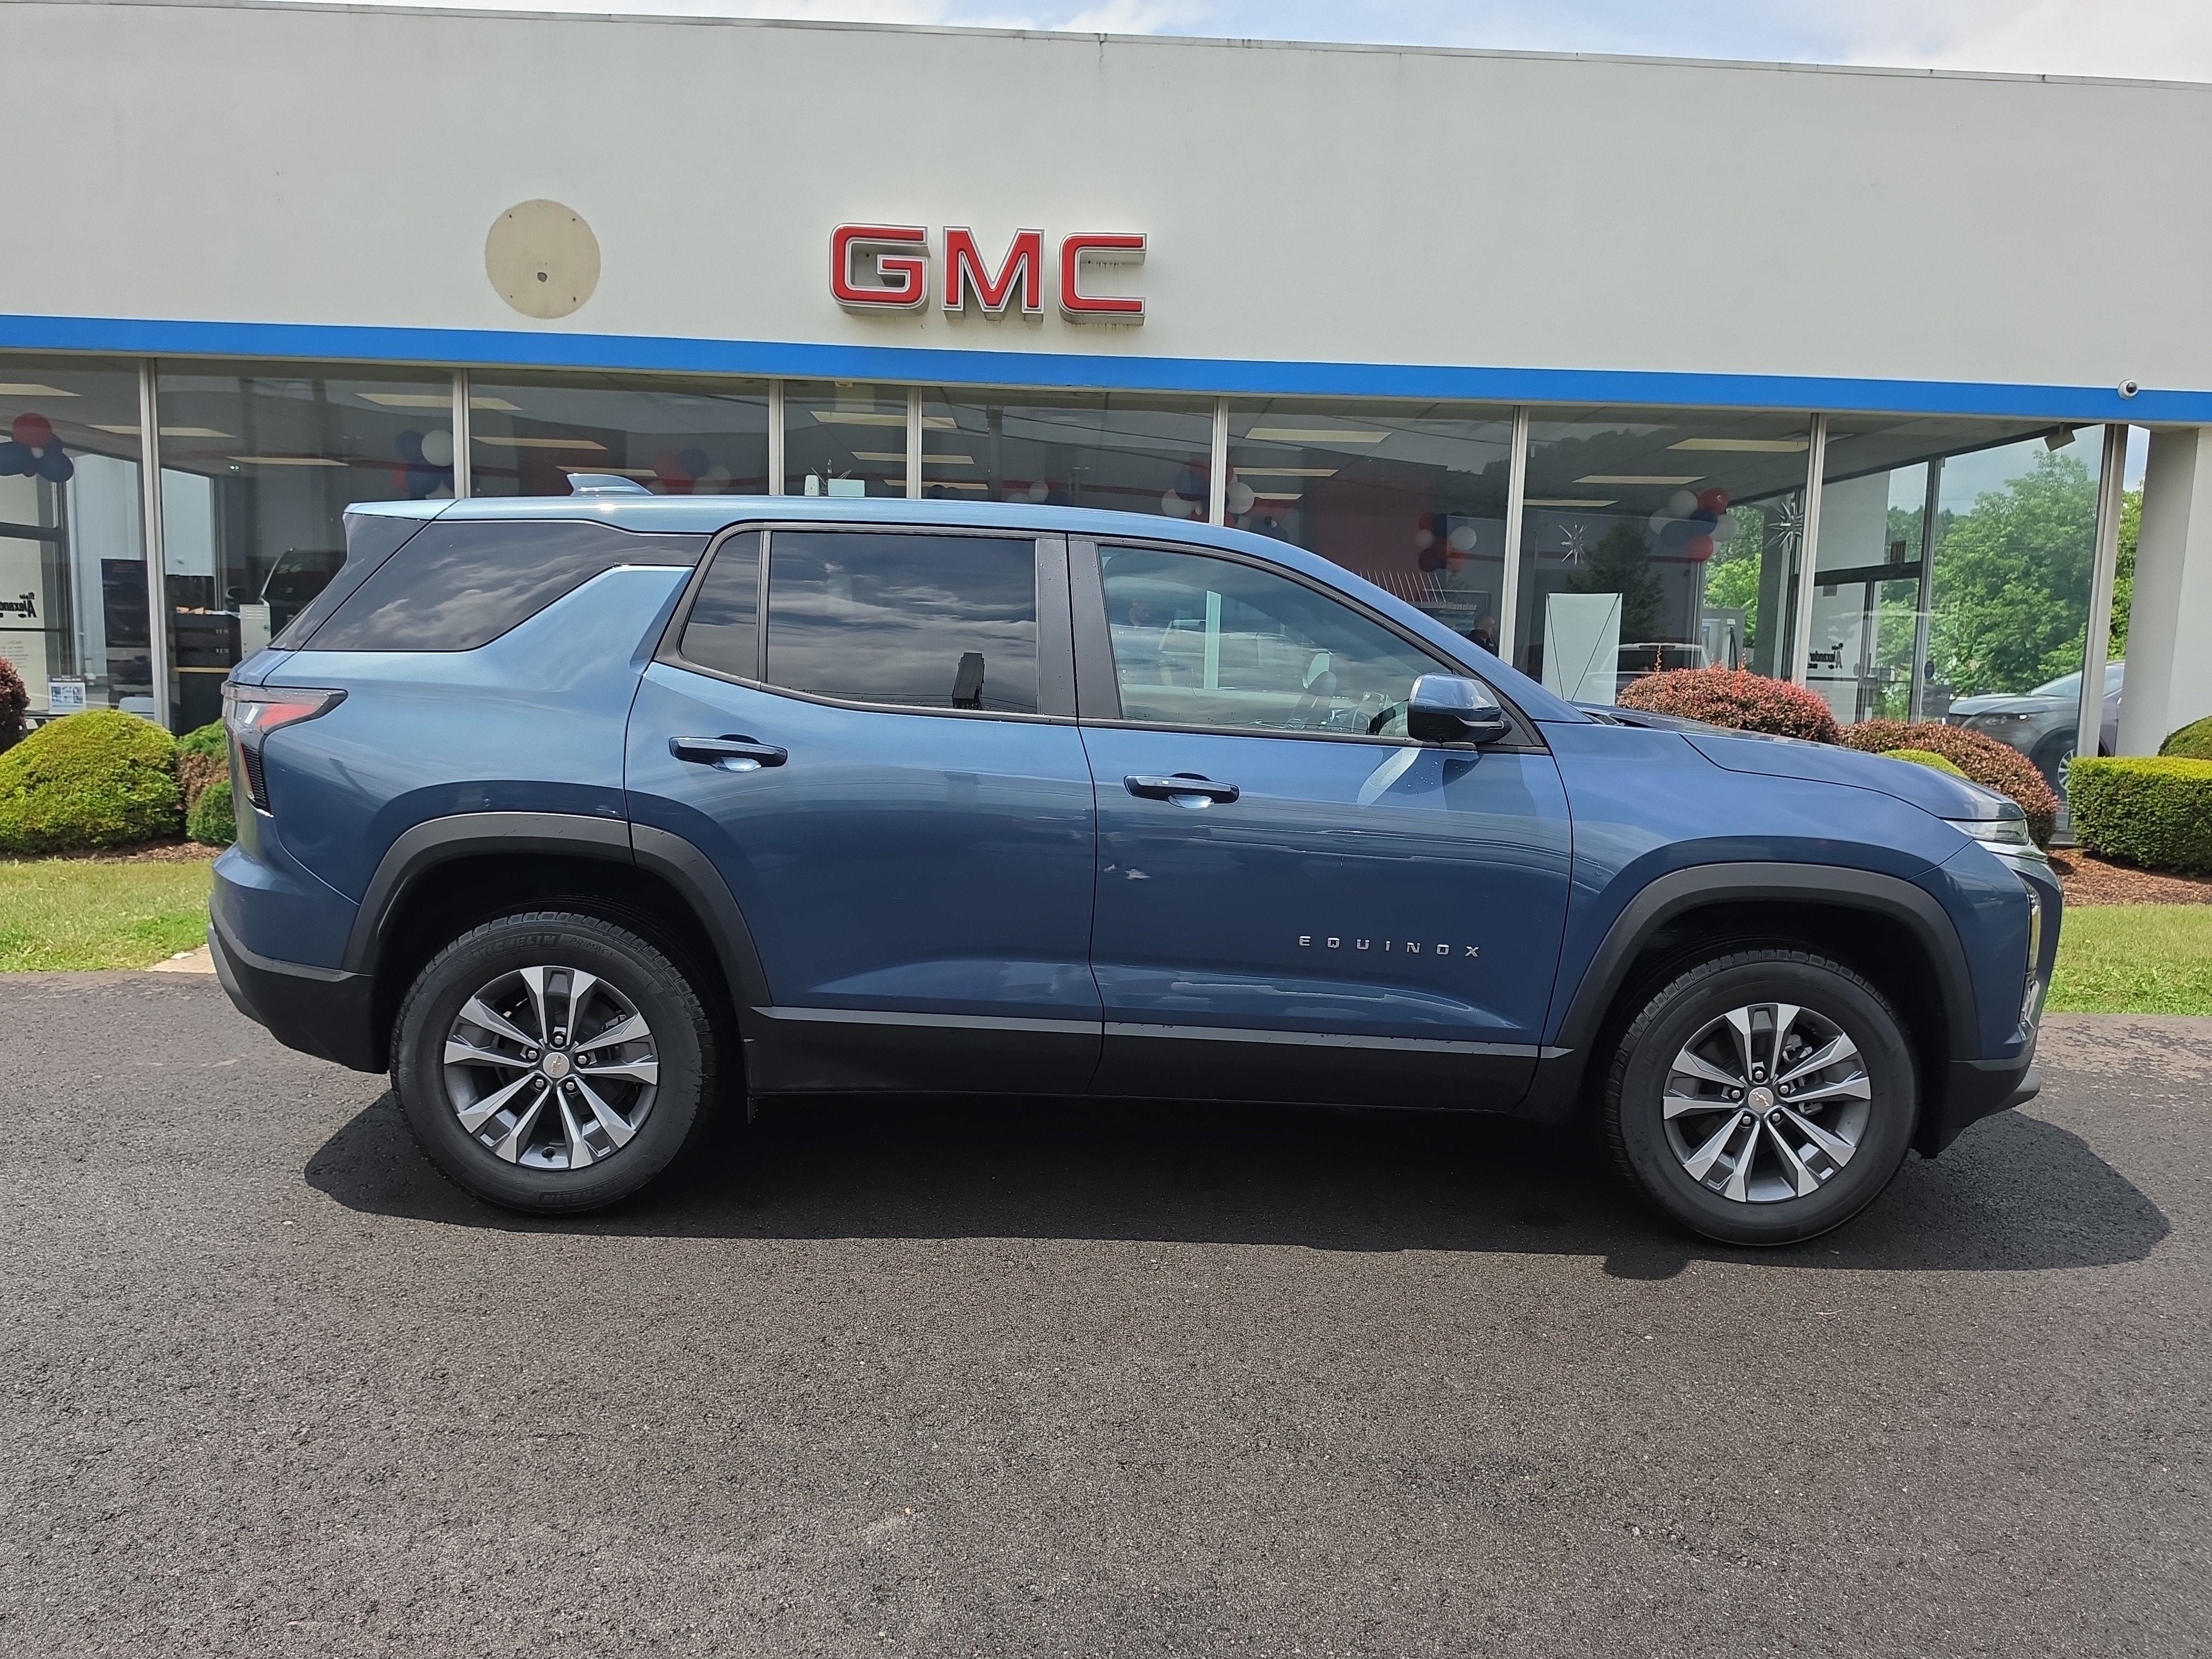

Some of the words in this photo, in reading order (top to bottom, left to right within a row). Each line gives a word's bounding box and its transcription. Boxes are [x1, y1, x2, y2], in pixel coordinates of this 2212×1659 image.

[829, 222, 1147, 321] GMC
[569, 937, 616, 958] PRIMACY
[1299, 936, 1479, 957] EQUINOX
